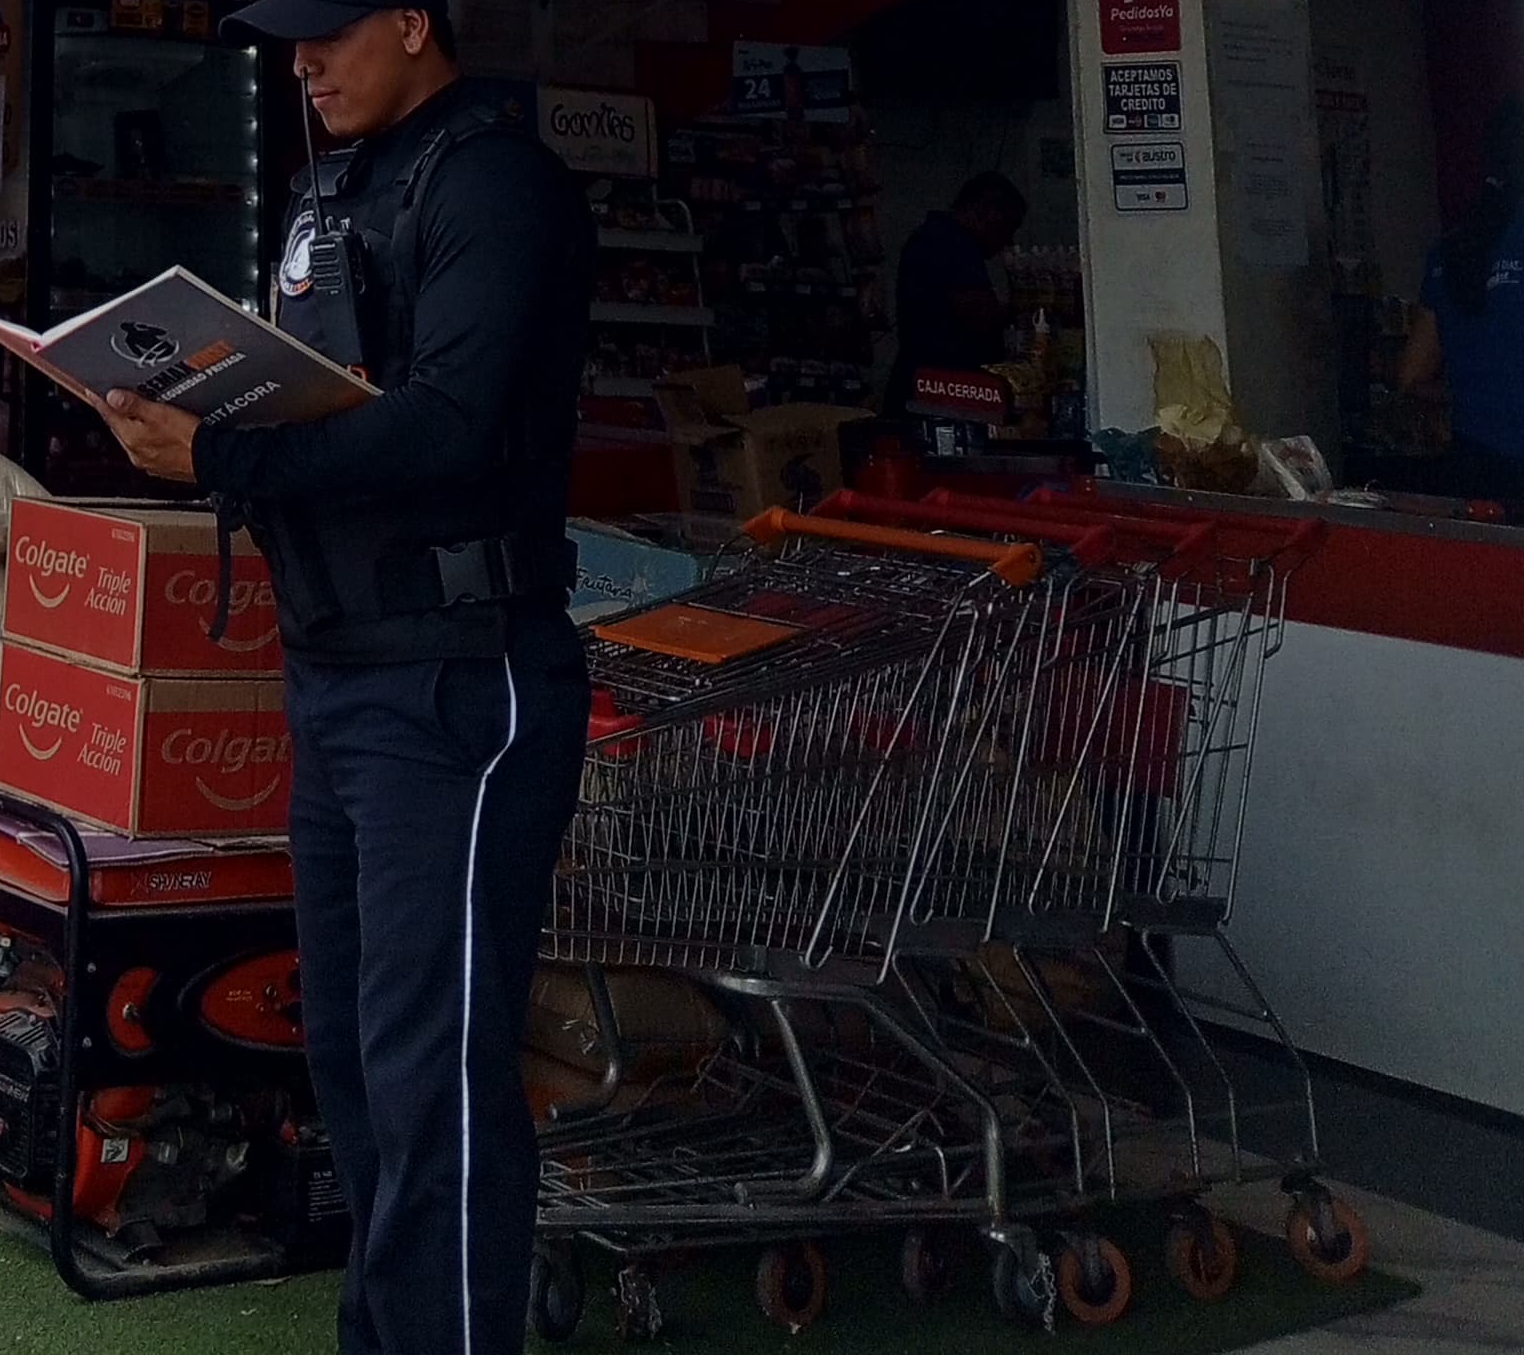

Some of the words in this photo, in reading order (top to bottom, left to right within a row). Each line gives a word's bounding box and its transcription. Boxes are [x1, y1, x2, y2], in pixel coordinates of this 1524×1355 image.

[1109, 4, 1175, 22] PedidosYa
[743, 77, 772, 100] 24
[1109, 67, 1174, 83] ACEPTAMOS
[1107, 82, 1161, 97] TARJETAS
[1162, 82, 1178, 96] DE
[1119, 96, 1167, 112] CREDITO
[161, 372, 208, 403] EGURIDAD
[205, 352, 248, 377] PRIVADA
[916, 378, 947, 396] CAJA
[947, 382, 1003, 404] CERRADA
[14, 535, 89, 579] Colgate
[97, 566, 132, 594] Triple
[164, 569, 277, 615] Coga
[84, 590, 127, 617] Acción
[4, 683, 83, 733] Colgate
[90, 722, 127, 755] Triple
[76, 744, 122, 776] Acción
